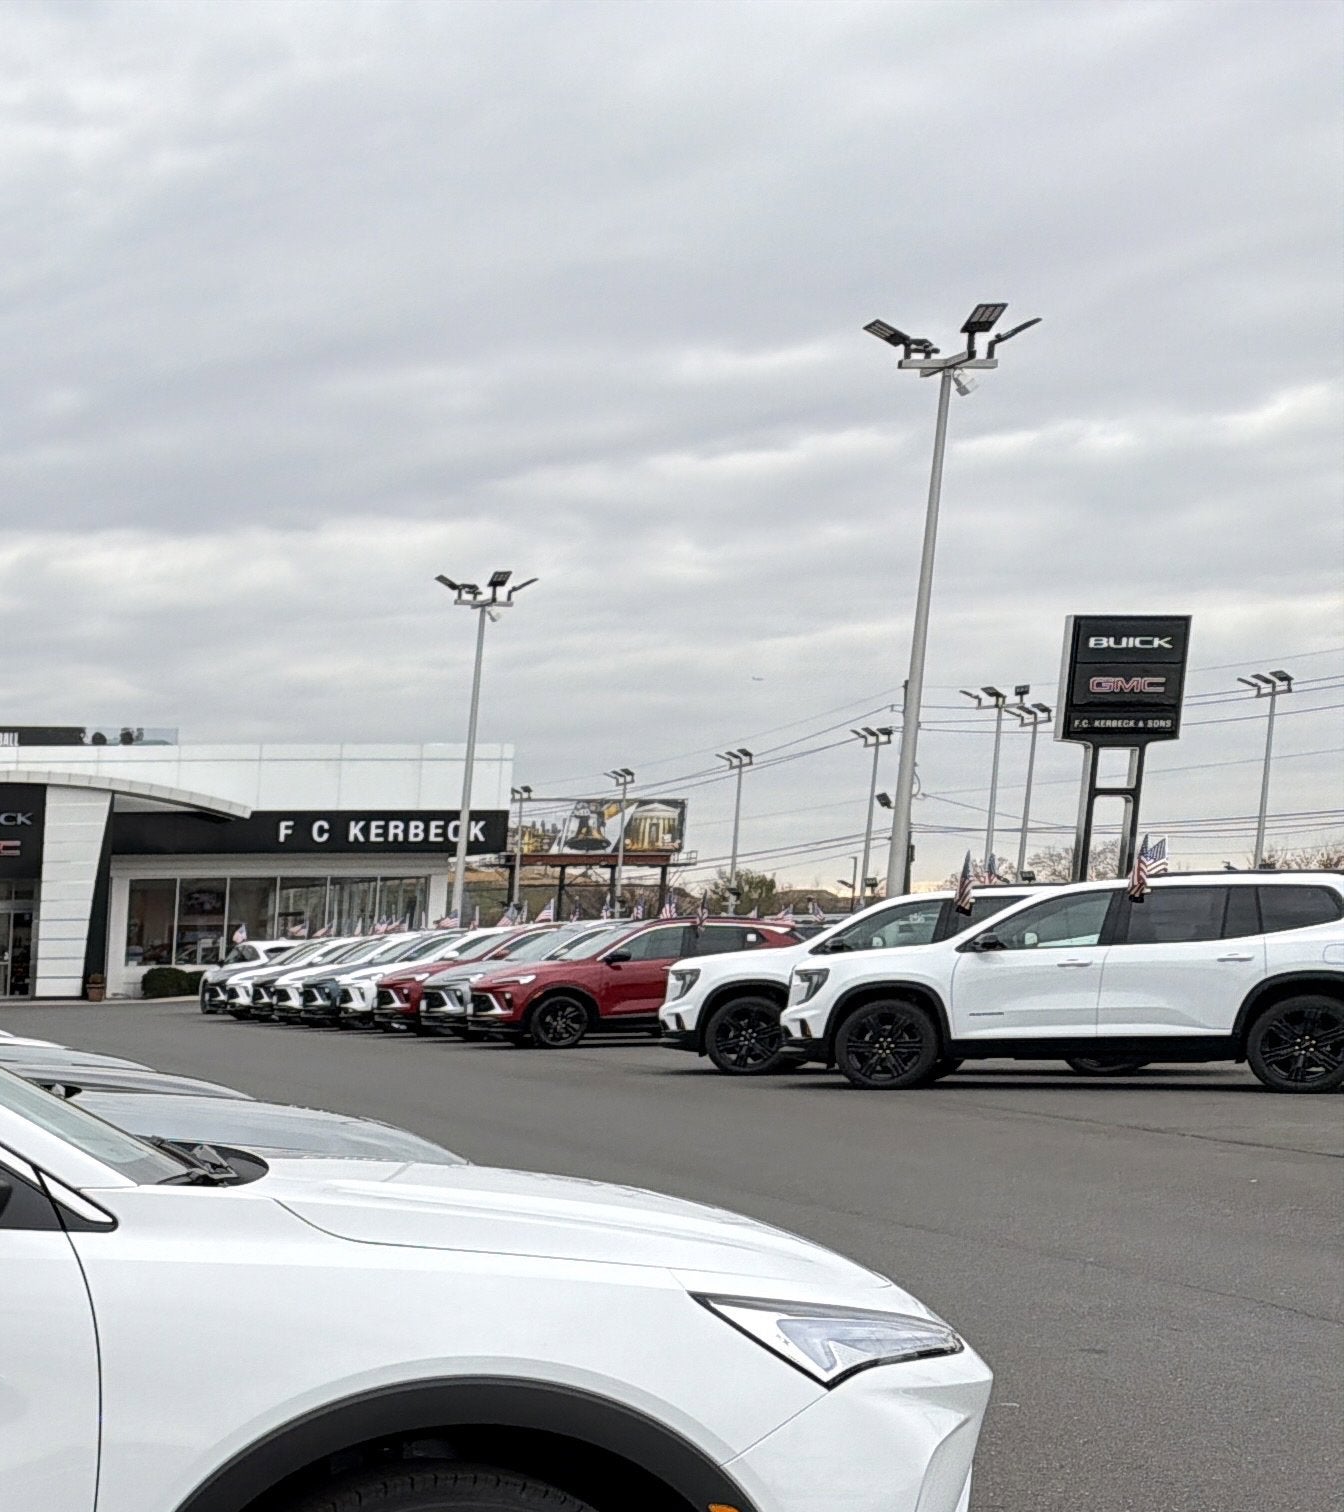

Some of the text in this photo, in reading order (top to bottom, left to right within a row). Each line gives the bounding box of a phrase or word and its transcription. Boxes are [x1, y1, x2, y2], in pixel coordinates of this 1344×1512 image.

[1088, 637, 1173, 648] BUICK
[1089, 677, 1166, 693] GMC
[1094, 719, 1135, 728] KERBECK
[1147, 719, 1172, 728] SONS
[278, 820, 486, 843] F C KERBECK
